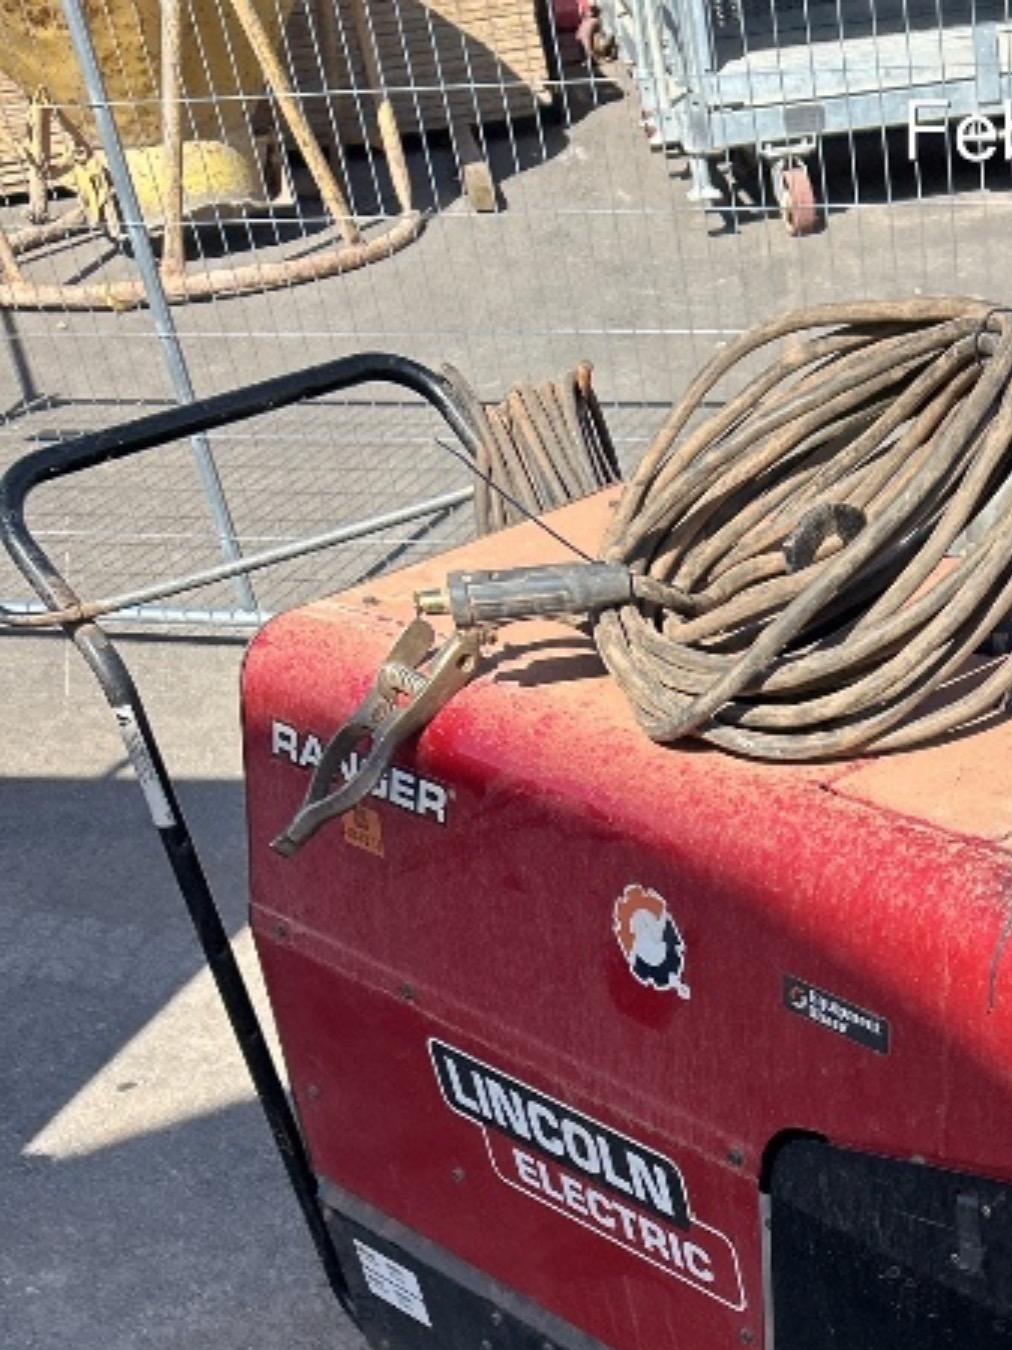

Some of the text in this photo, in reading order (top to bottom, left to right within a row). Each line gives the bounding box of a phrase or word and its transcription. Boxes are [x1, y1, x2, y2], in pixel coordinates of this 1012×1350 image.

[272, 719, 449, 824] RANER
[442, 1055, 676, 1217] LINCOLN
[511, 1147, 715, 1283] ELECTRIC
